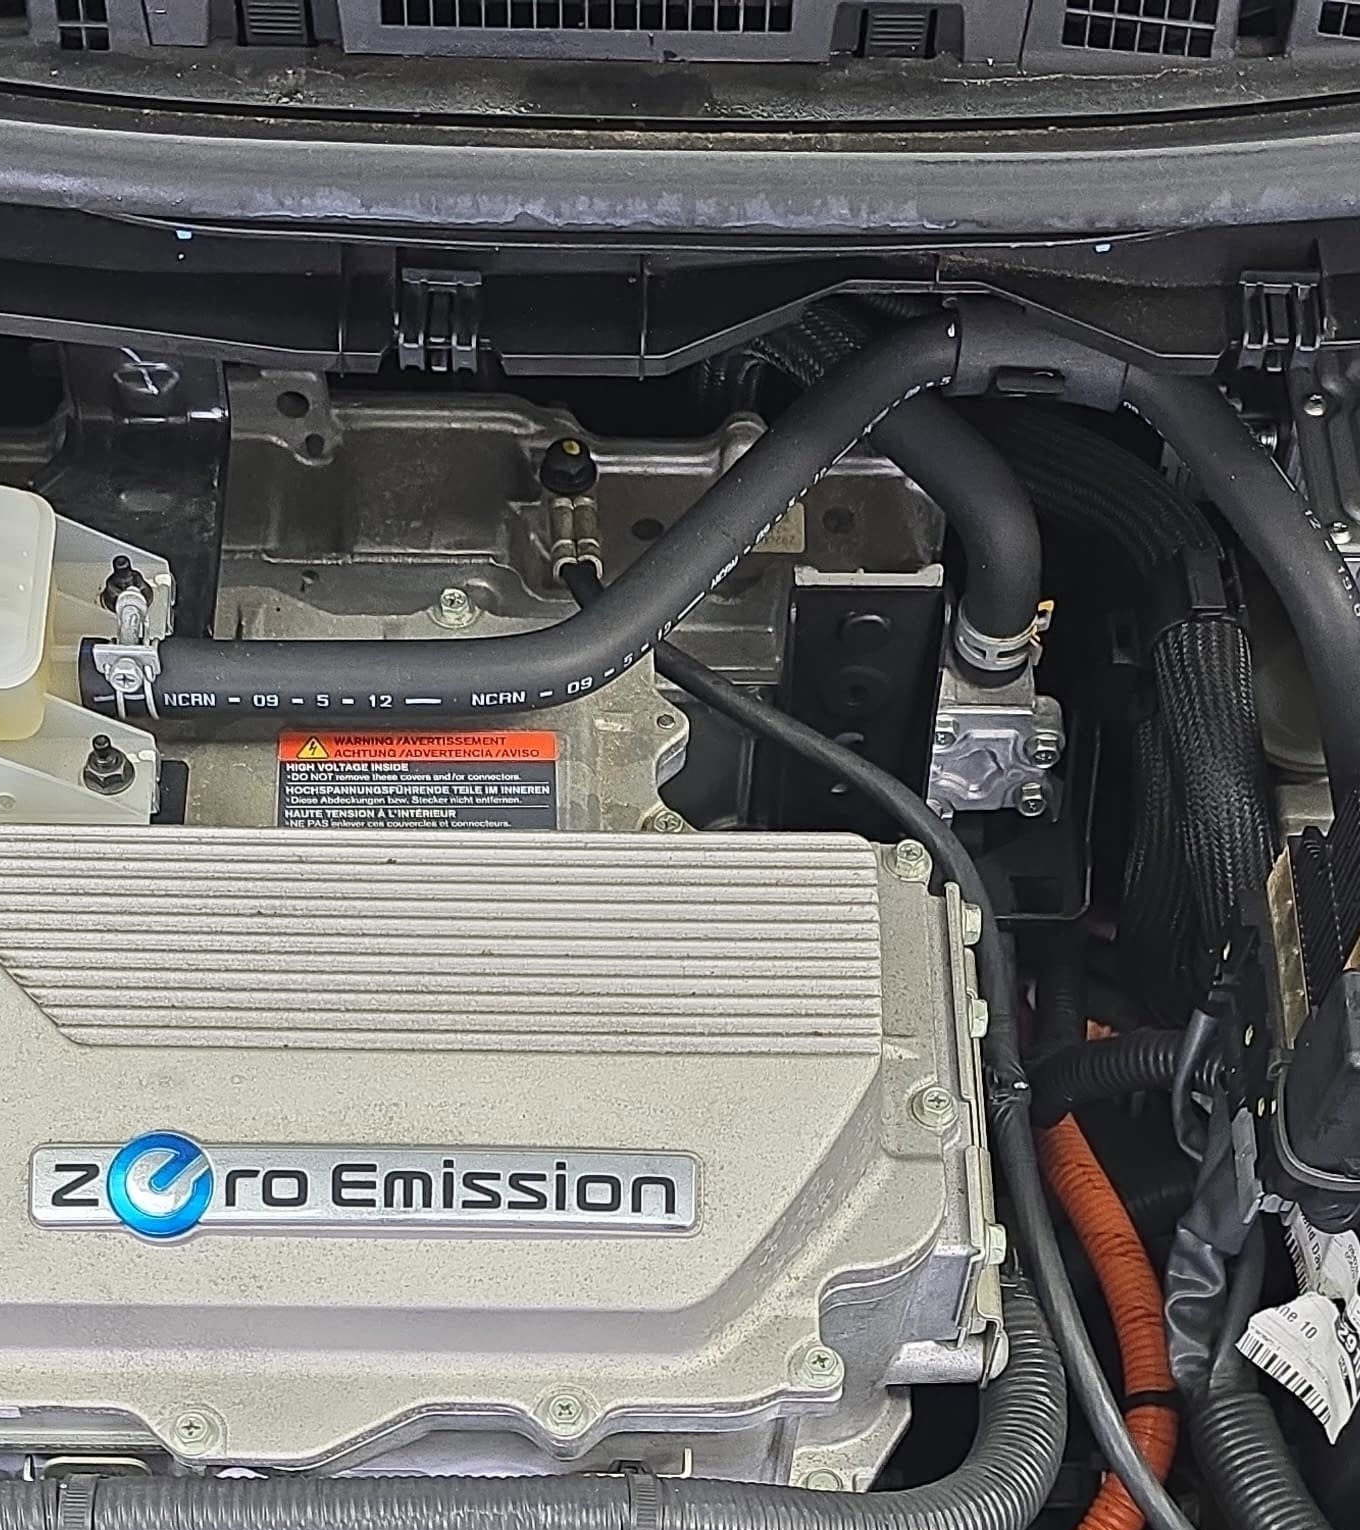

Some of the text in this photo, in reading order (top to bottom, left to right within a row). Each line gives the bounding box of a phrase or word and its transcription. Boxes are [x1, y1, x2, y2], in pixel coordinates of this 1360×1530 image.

[164, 693, 216, 707] NCRN
[253, 693, 279, 707] 09
[316, 694, 330, 707] 5
[368, 693, 393, 707] 12
[471, 691, 526, 707] NCRN
[566, 675, 594, 695] 09
[334, 737, 393, 746] WARNING
[334, 750, 397, 758] ACHTUNG
[286, 763, 409, 771] HIGH VOLTAGE INSIDE
[310, 773, 334, 781] NOT
[453, 785, 482, 794] TEILE
[485, 785, 498, 794] IM
[501, 785, 550, 794] INNEREN
[285, 810, 323, 818] HAUTE
[325, 810, 374, 818] TENSION
[331, 1161, 679, 1215] Emission
[1299, 1319, 1319, 1341] 10
